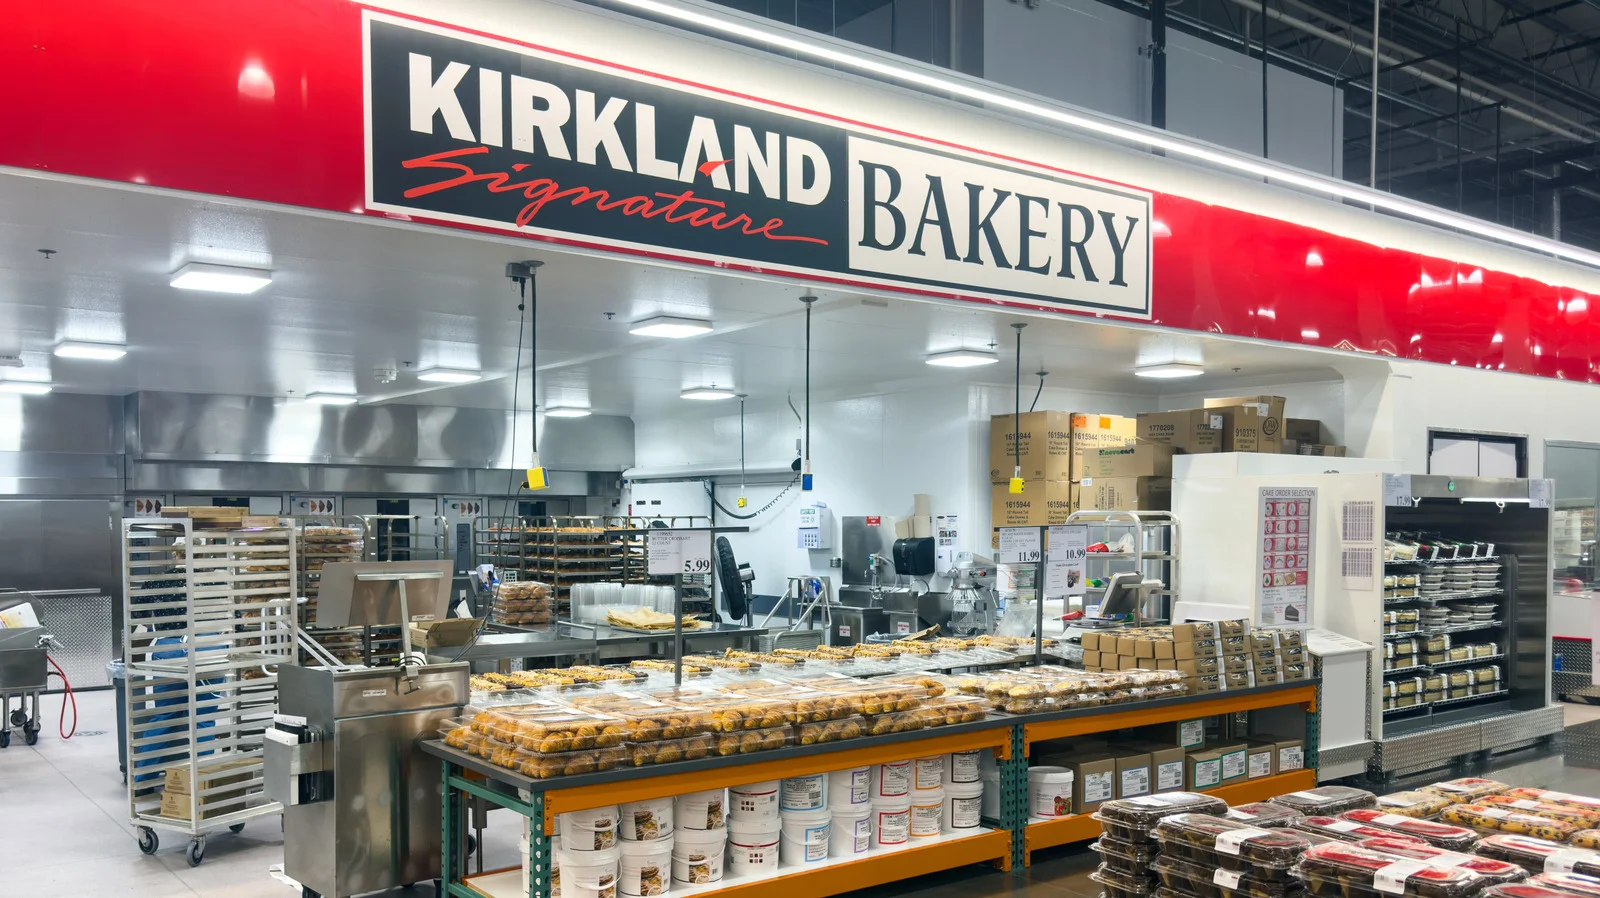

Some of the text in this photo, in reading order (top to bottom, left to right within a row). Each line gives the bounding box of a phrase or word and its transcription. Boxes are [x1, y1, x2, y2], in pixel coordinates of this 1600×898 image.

[409, 52, 831, 206] KIRKLAND
[402, 146, 829, 246] Signature
[858, 160, 1139, 287] BAKERY
[1005, 432, 1031, 440] 161944
[1047, 431, 1070, 439] 1615944
[1074, 432, 1098, 440] 1615944
[1235, 428, 1256, 438] 910375
[1262, 489, 1316, 497] CAKE ORDER SELECTION
[1018, 551, 1040, 562] 11.99
[1066, 549, 1086, 560] 10.99
[684, 559, 710, 573] 5.99
